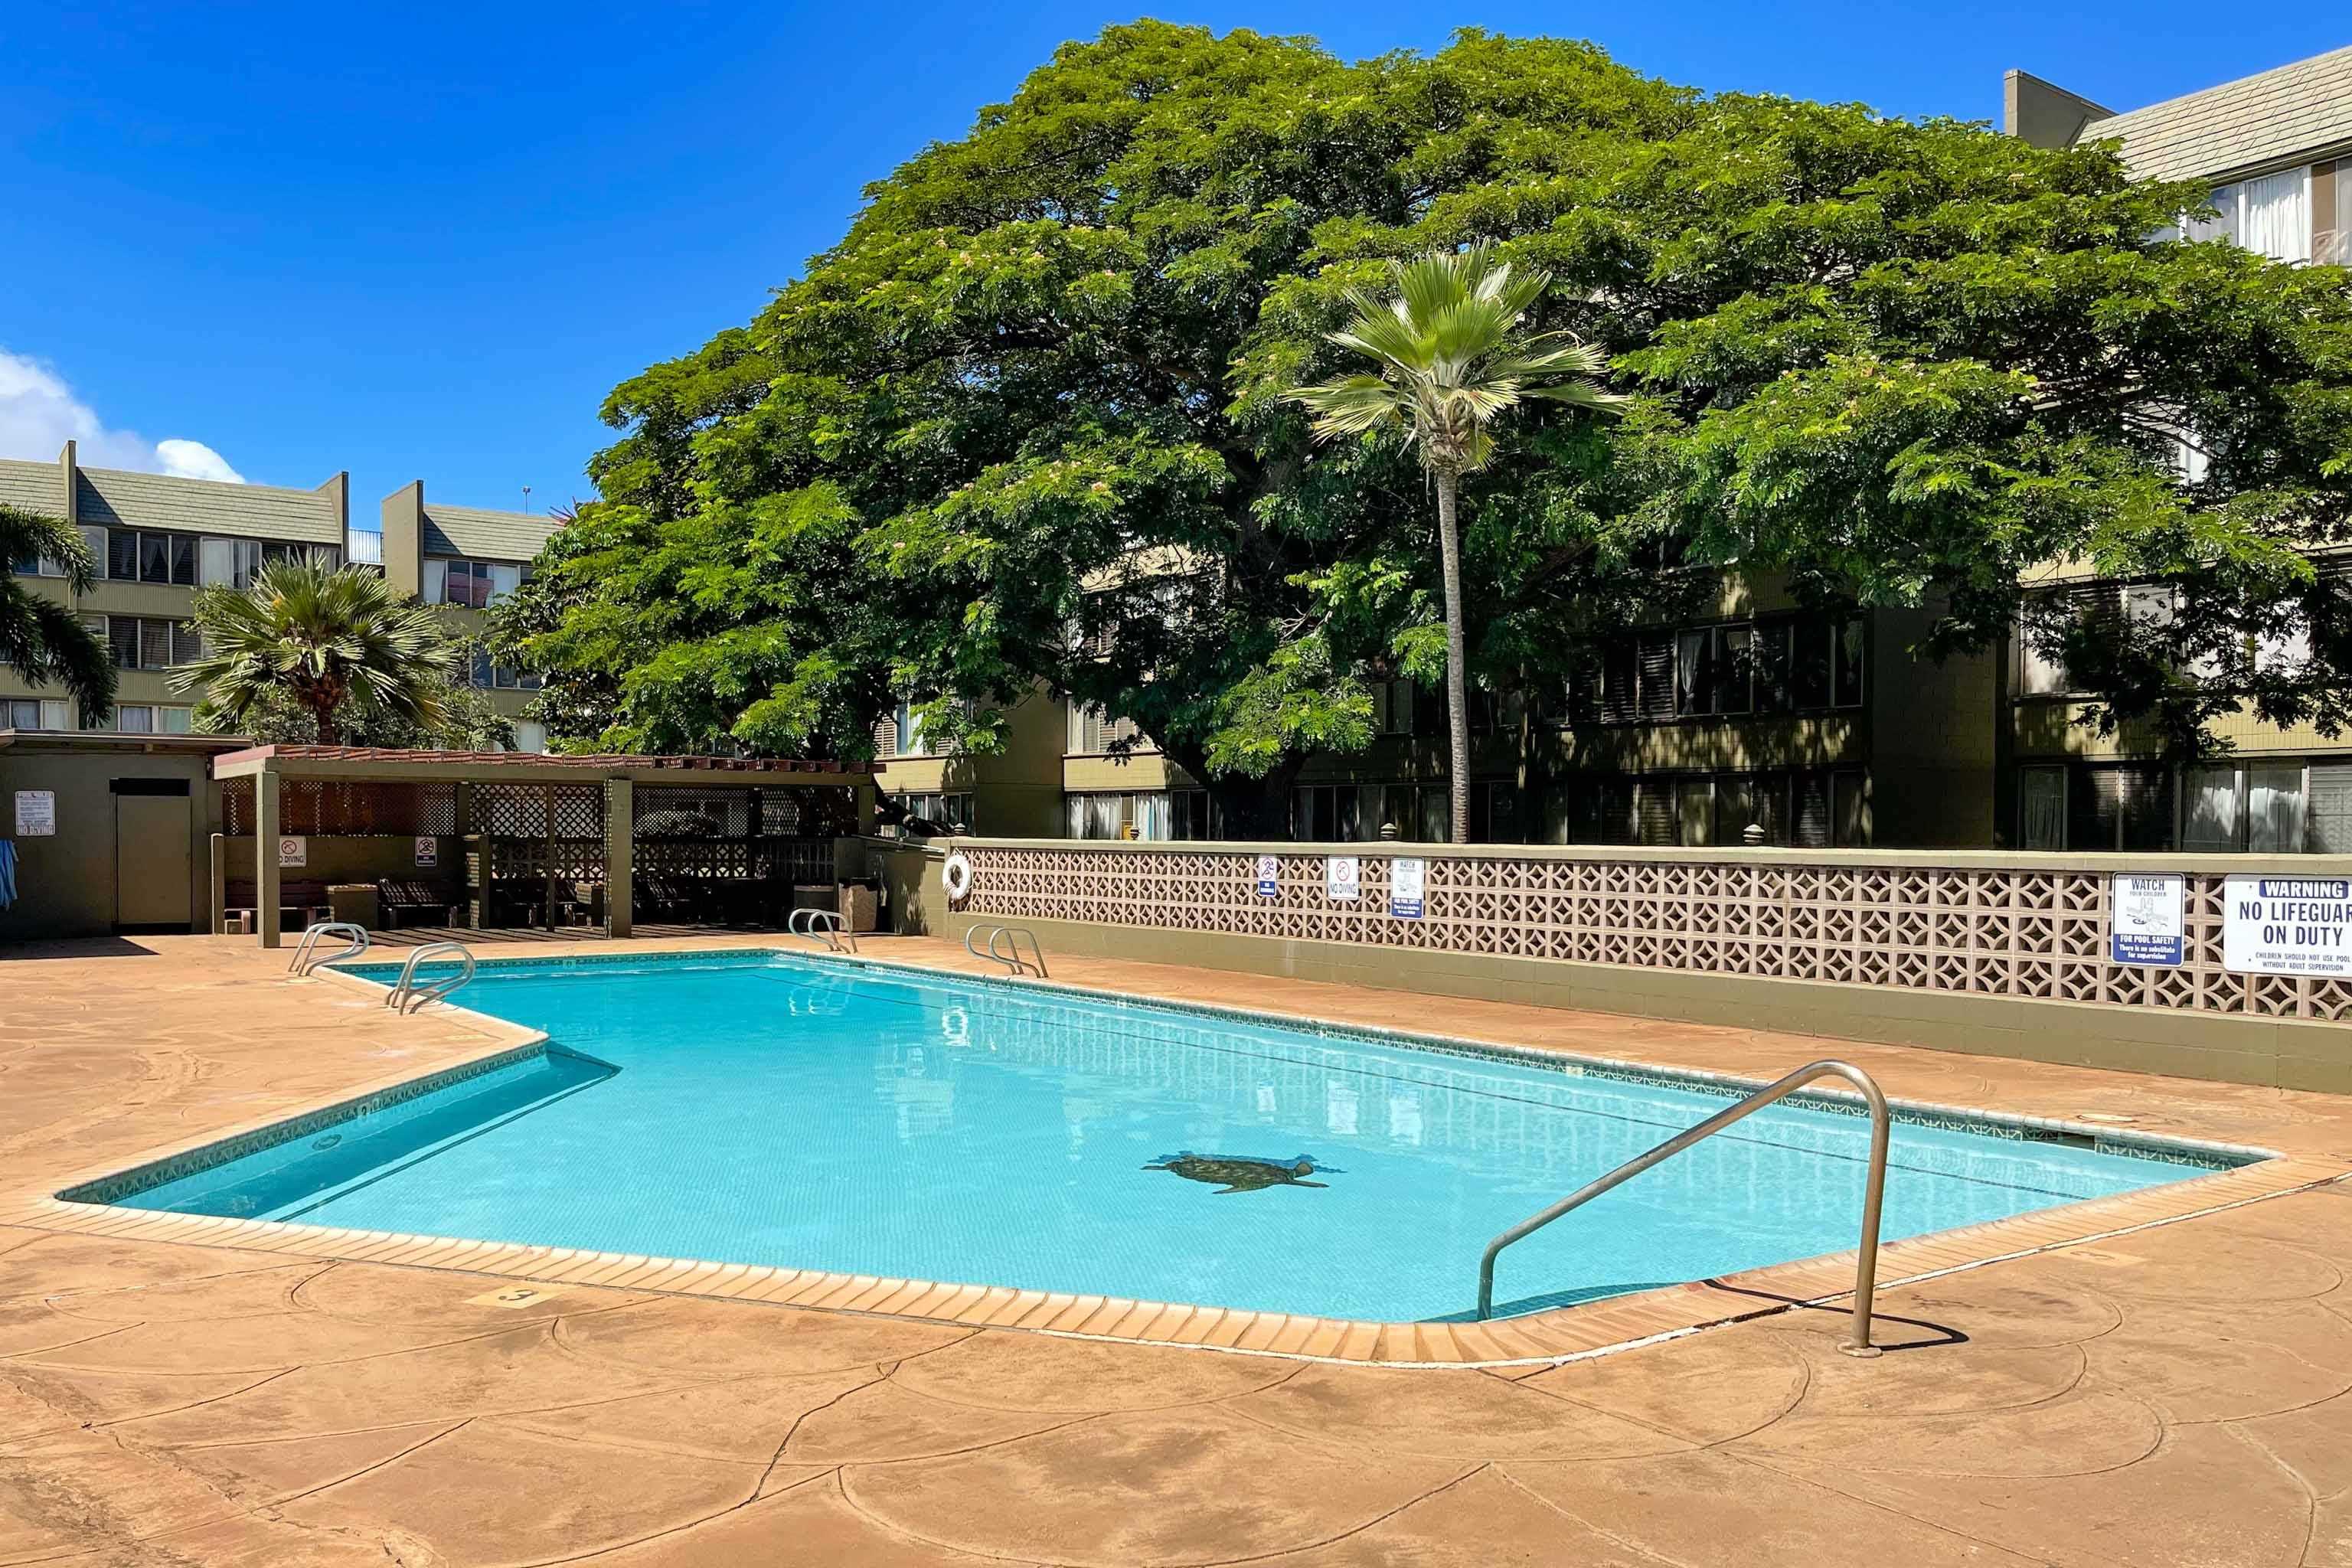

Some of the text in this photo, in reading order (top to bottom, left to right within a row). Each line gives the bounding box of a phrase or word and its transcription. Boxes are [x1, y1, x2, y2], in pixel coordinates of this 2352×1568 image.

[1330, 884, 1356, 894] NO DIVING
[2132, 878, 2164, 890] WATCH
[2265, 880, 2344, 898] WARNING
[2239, 901, 2262, 920] NO
[2263, 925, 2343, 946] ON DUTY
